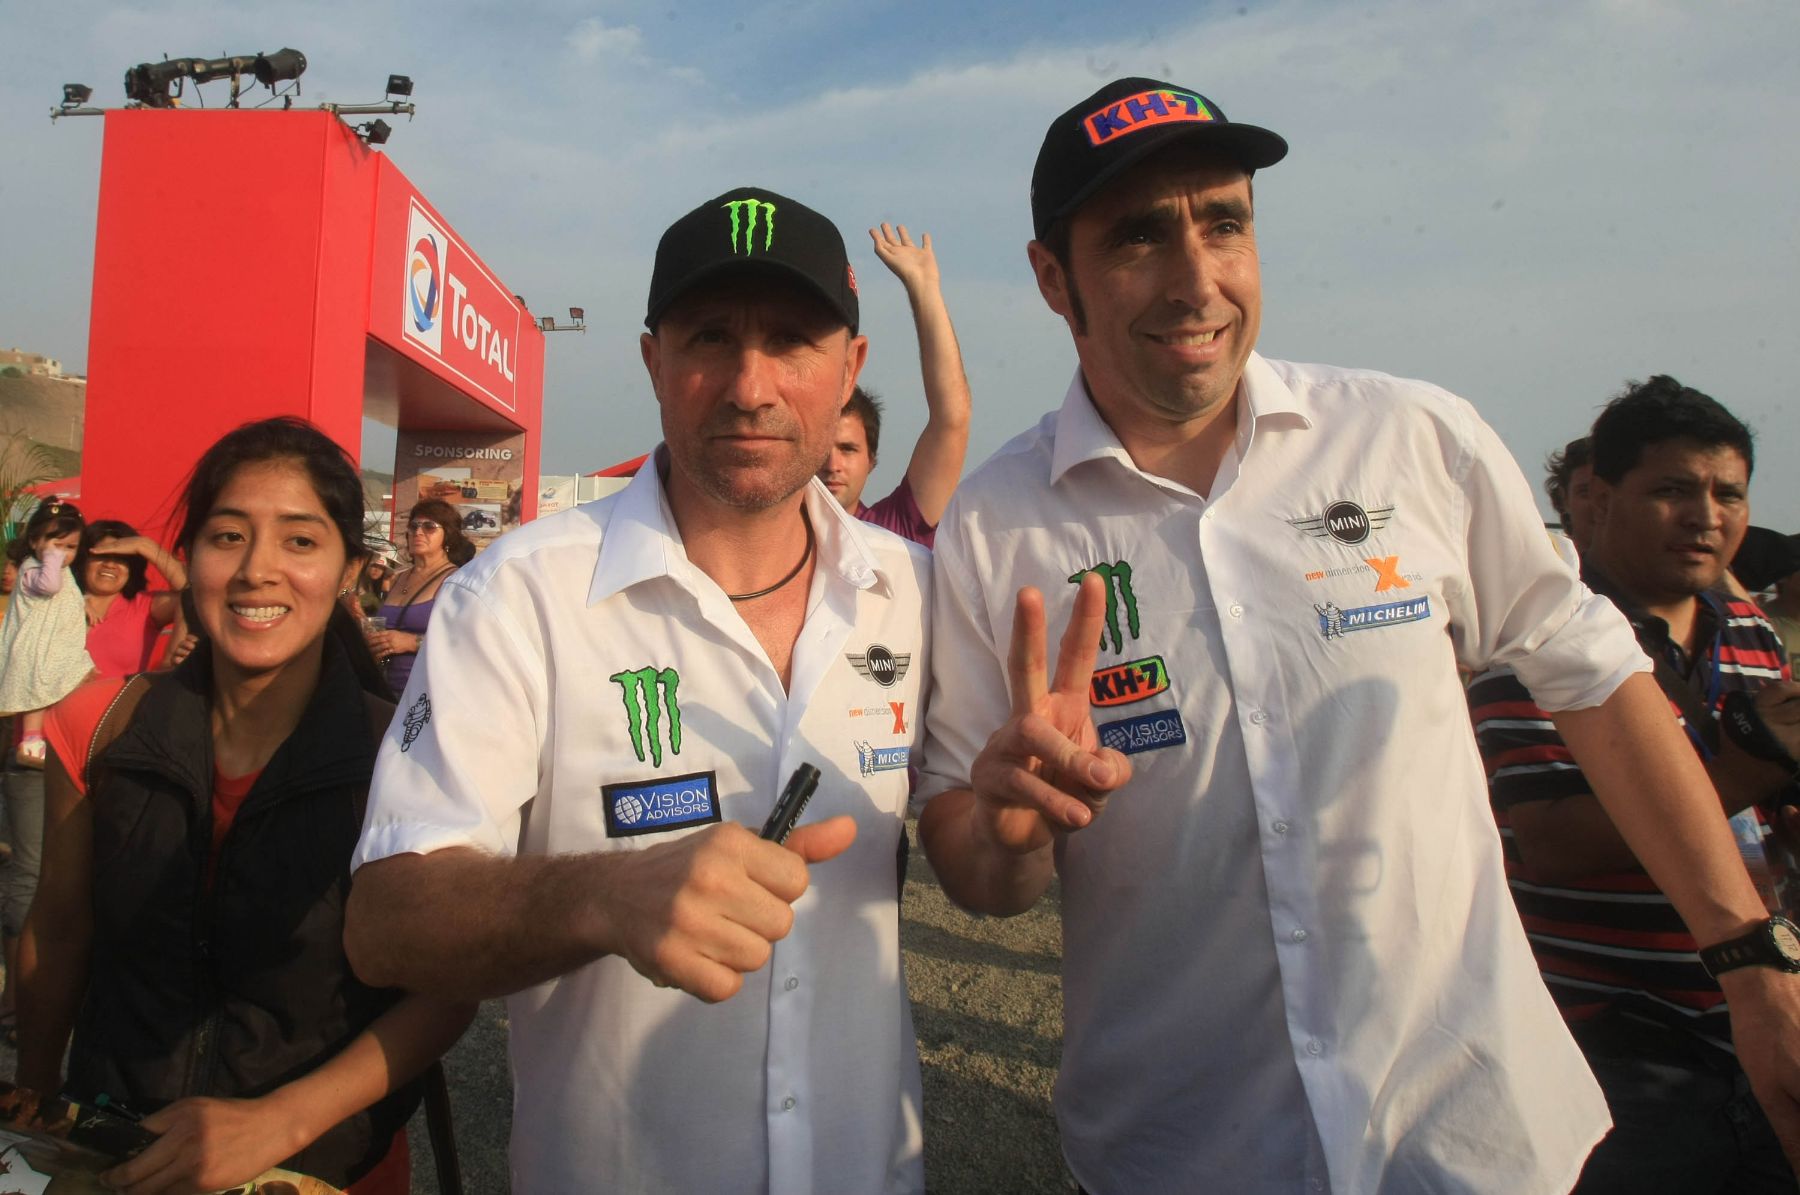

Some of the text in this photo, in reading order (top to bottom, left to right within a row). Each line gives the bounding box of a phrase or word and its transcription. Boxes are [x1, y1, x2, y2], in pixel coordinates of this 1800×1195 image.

[1091, 93, 1199, 140] KH-7
[448, 273, 514, 383] TOTAL
[415, 444, 513, 461] SPONSORING
[1329, 514, 1366, 532] MINI
[1304, 570, 1325, 582] new
[1349, 601, 1426, 625] MICHELIN
[870, 658, 896, 672] MINI
[1091, 661, 1159, 702] KH-7
[1121, 717, 1180, 740] VISION
[1732, 711, 1753, 735] JVC
[1129, 728, 1183, 749] ADVISORS
[639, 787, 708, 810] VISION
[645, 802, 710, 822] ADVISORS
